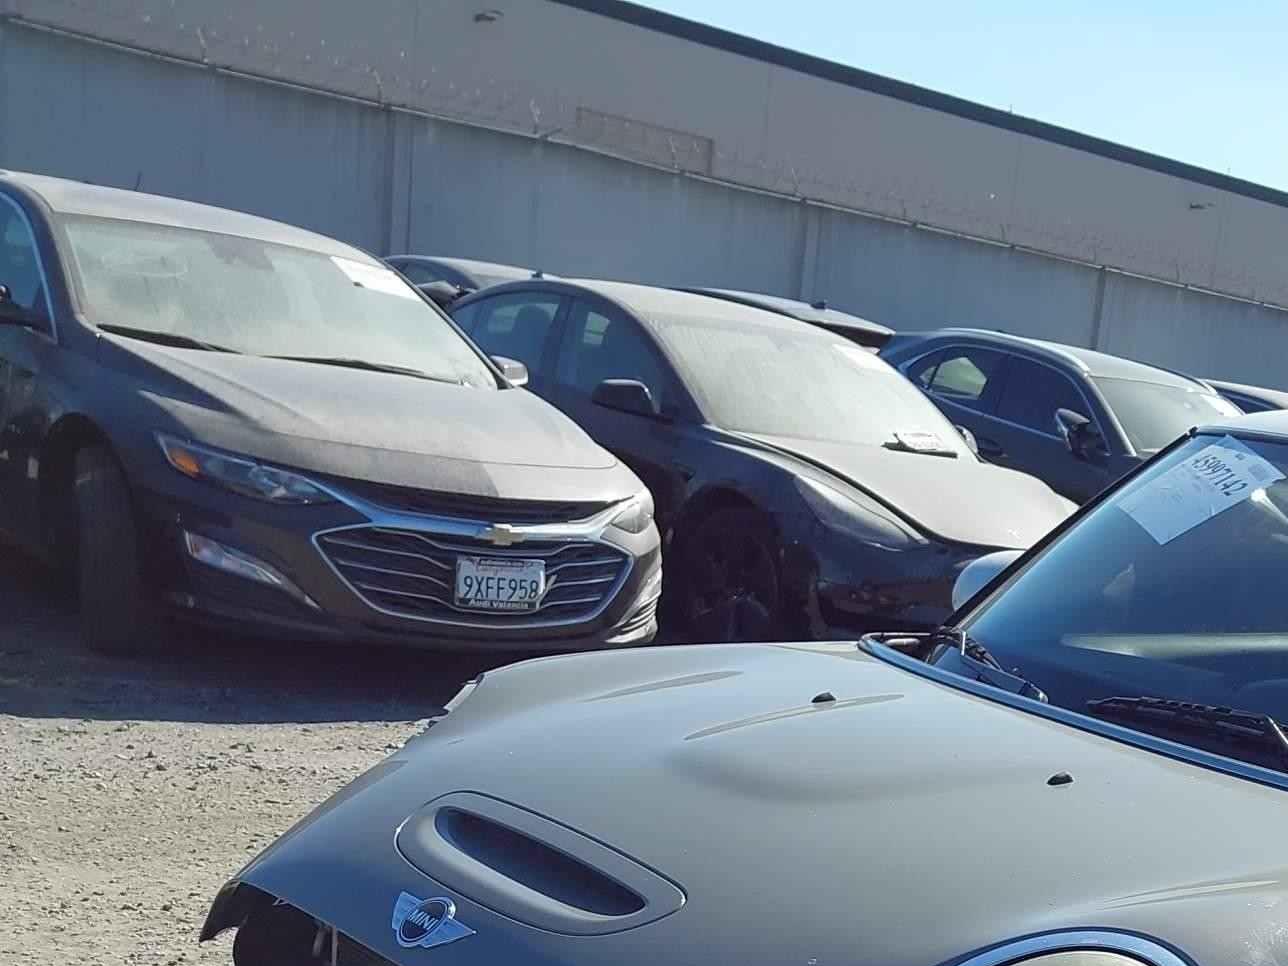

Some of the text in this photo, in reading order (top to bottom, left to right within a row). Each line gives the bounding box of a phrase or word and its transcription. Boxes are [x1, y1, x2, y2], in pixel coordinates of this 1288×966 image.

[1191, 454, 1248, 497] 45997142
[463, 575, 539, 600] 9XFF958
[469, 599, 529, 609] Audi Valencia
[406, 908, 440, 931] MINI
